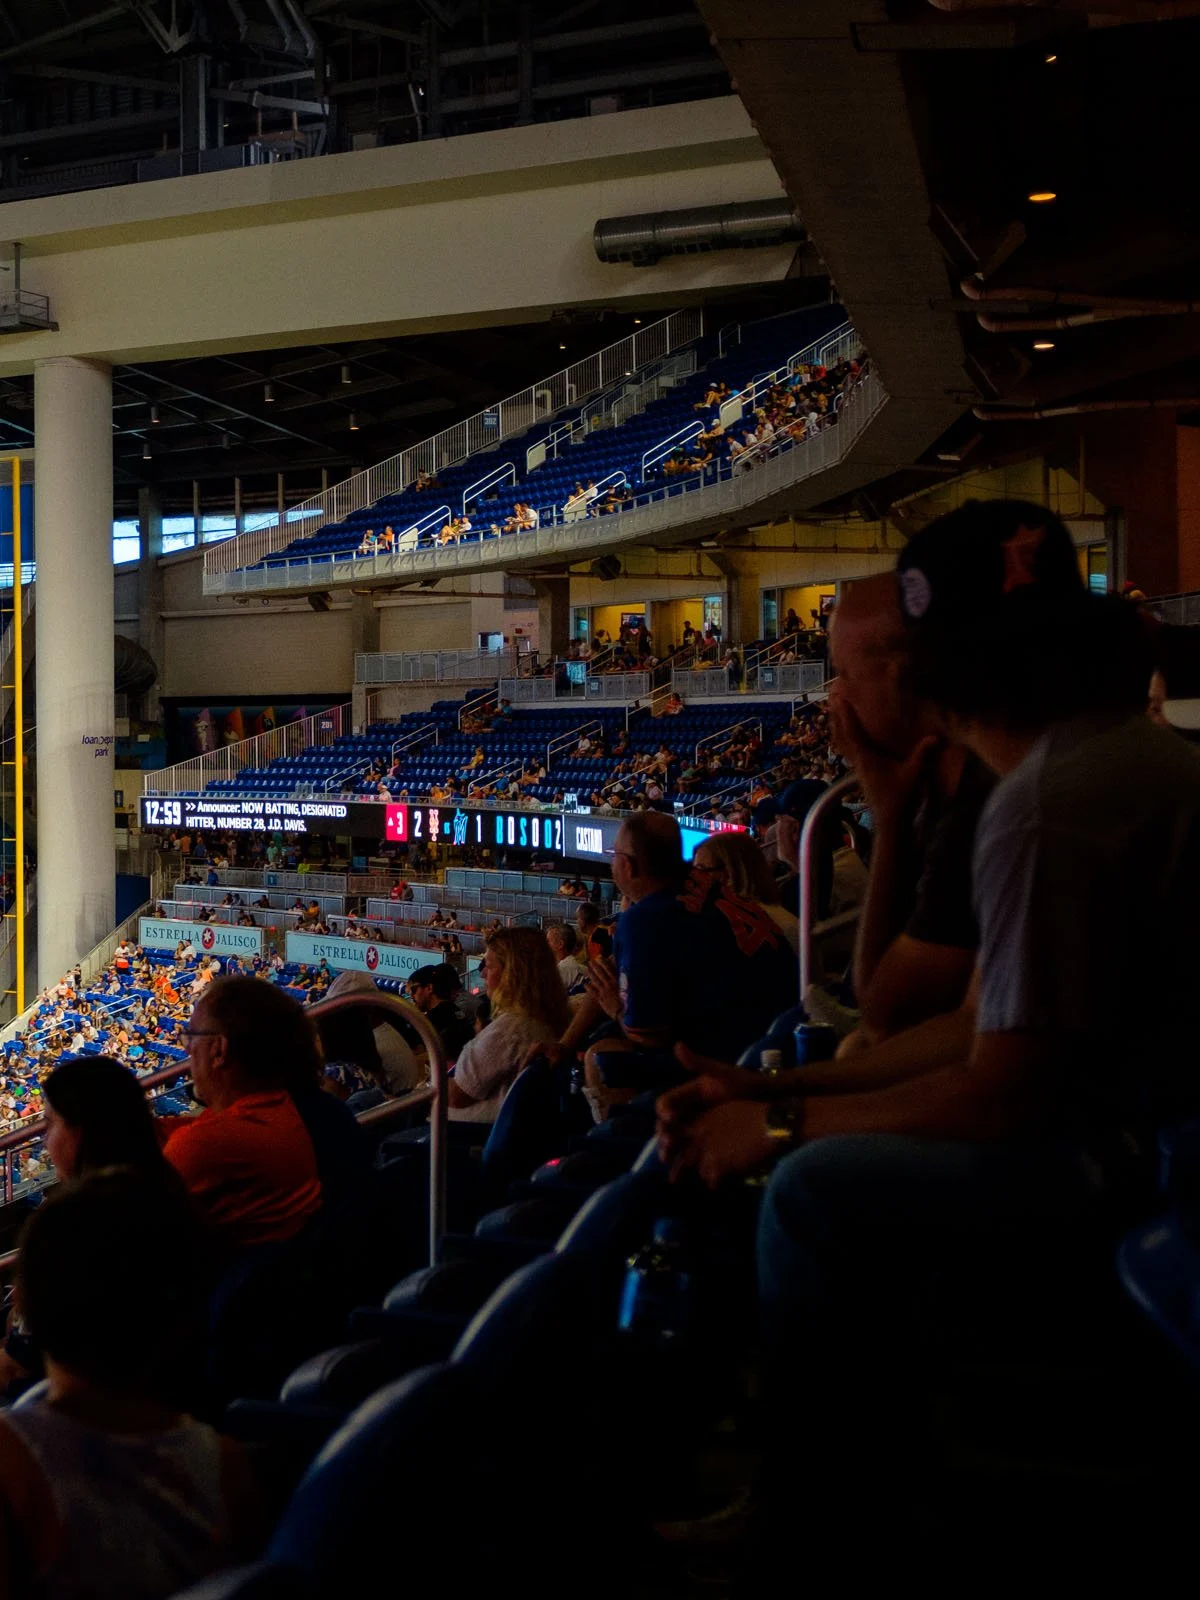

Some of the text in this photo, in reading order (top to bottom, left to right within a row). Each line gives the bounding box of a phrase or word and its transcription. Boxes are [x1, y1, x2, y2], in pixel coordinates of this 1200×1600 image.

[145, 800, 181, 825] 12:59
[197, 802, 240, 814] Announcer:
[242, 802, 263, 814] NOW
[265, 803, 300, 815] BATTING,
[302, 804, 346, 817] DESIGNATED
[186, 817, 307, 832] HITTER, NUMBER 28, J.D. DAVIS.
[397, 811, 404, 835] 3
[414, 810, 422, 837] 2
[476, 814, 482, 843] 1
[519, 817, 527, 846] S
[555, 819, 561, 850] 2
[145, 926, 258, 949] ESTRELLA JALISCO
[313, 944, 420, 971] ESTRELLA JALISCO
